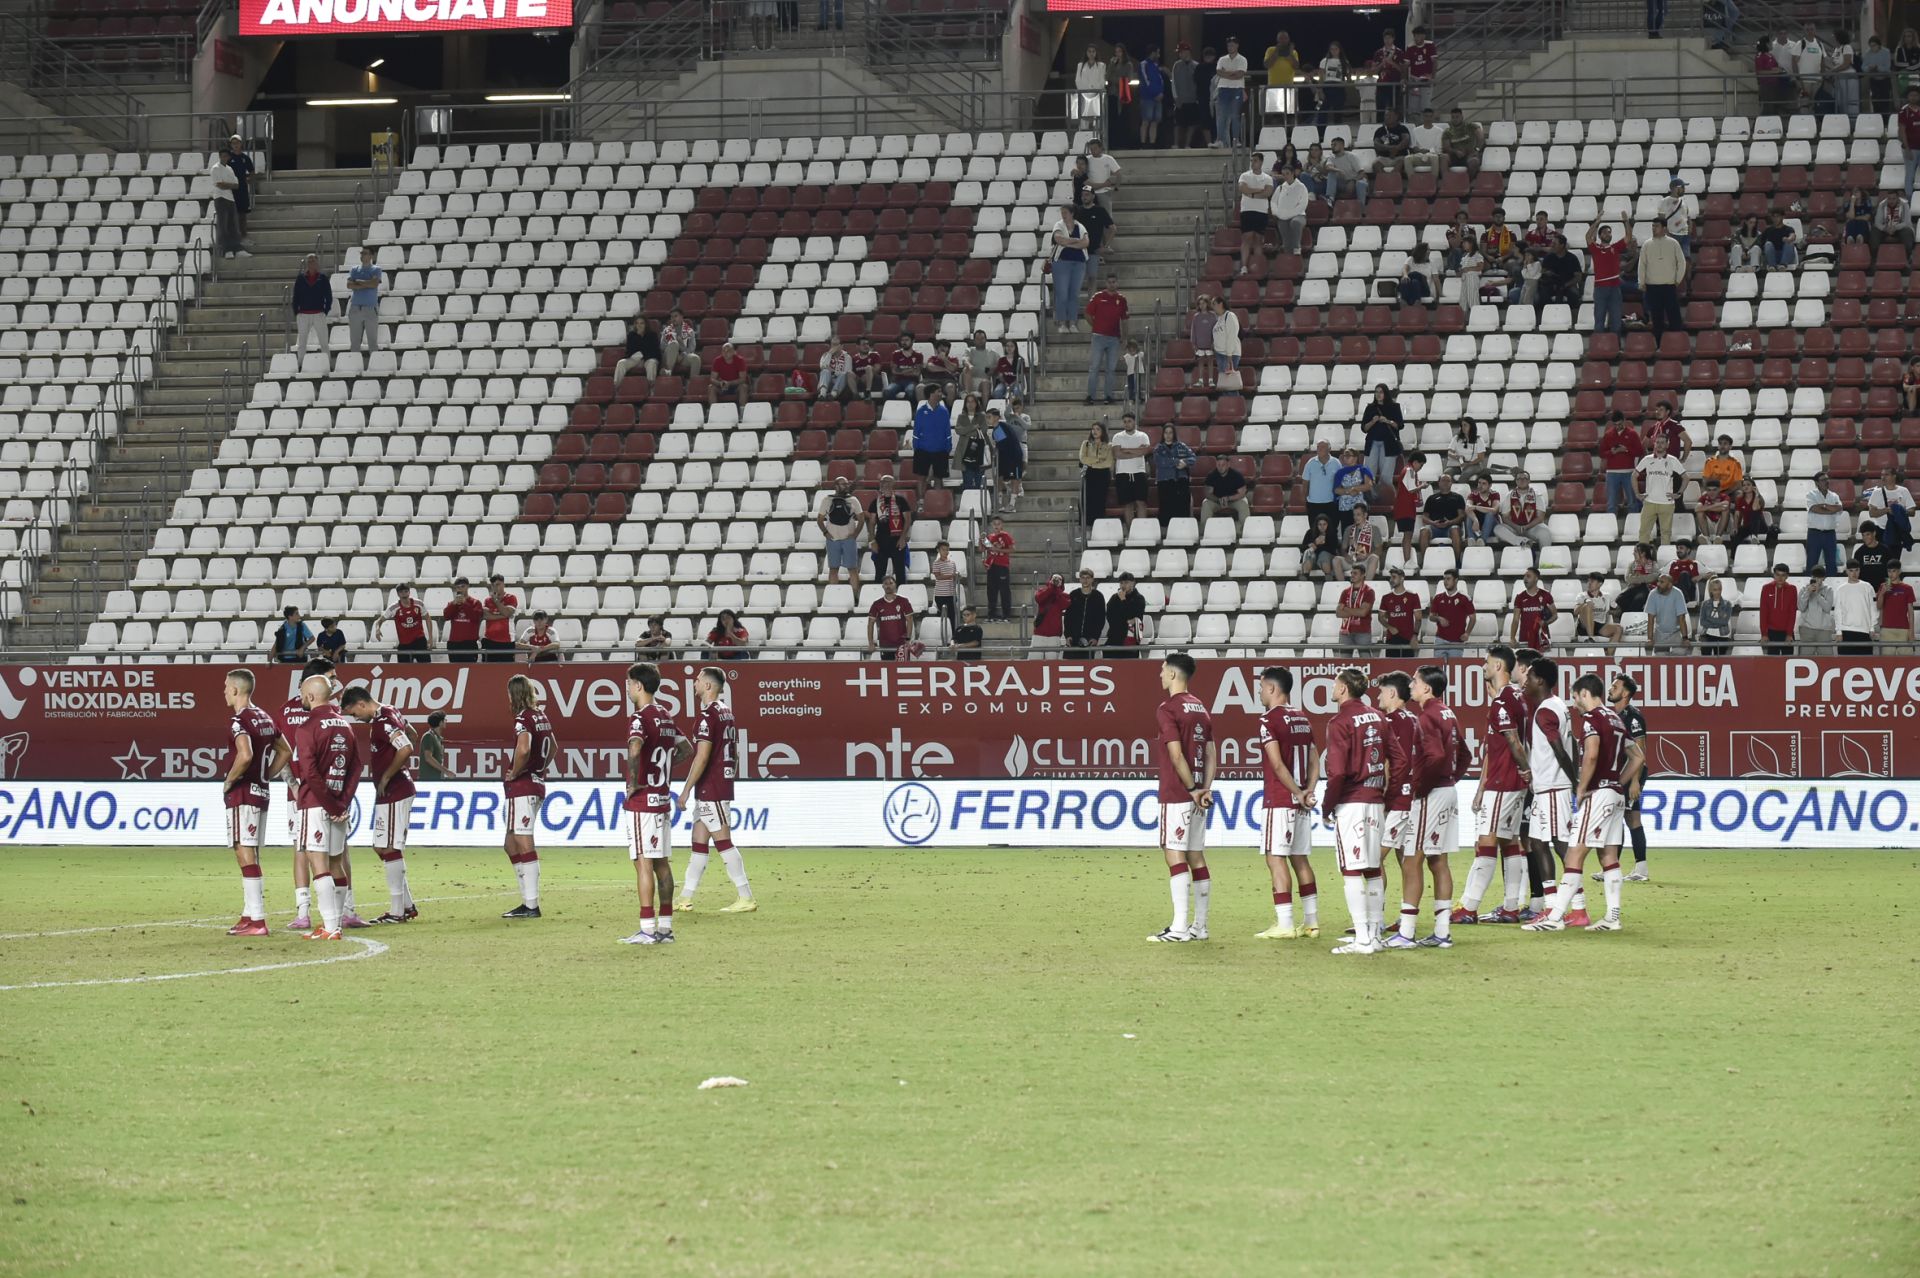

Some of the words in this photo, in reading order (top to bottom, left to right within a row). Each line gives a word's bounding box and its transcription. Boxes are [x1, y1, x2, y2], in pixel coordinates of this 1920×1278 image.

[1863, 554, 1883, 562] EA7
[43, 671, 118, 688] VENTA
[125, 671, 155, 687] DE
[758, 678, 821, 690] everything
[846, 665, 1116, 697] HERRAJES
[44, 692, 196, 710] INOXIDABLES
[759, 692, 795, 702] about
[45, 710, 98, 719] DISTRIBUCIÓN
[106, 710, 157, 719] FABRICACIÓN
[759, 704, 822, 717] packaging
[897, 701, 1116, 714] EXPOMURCIA
[1785, 701, 1916, 717] PREVENCIÓ
[846, 727, 955, 778] nte
[1032, 737, 1152, 766] CLIMA
